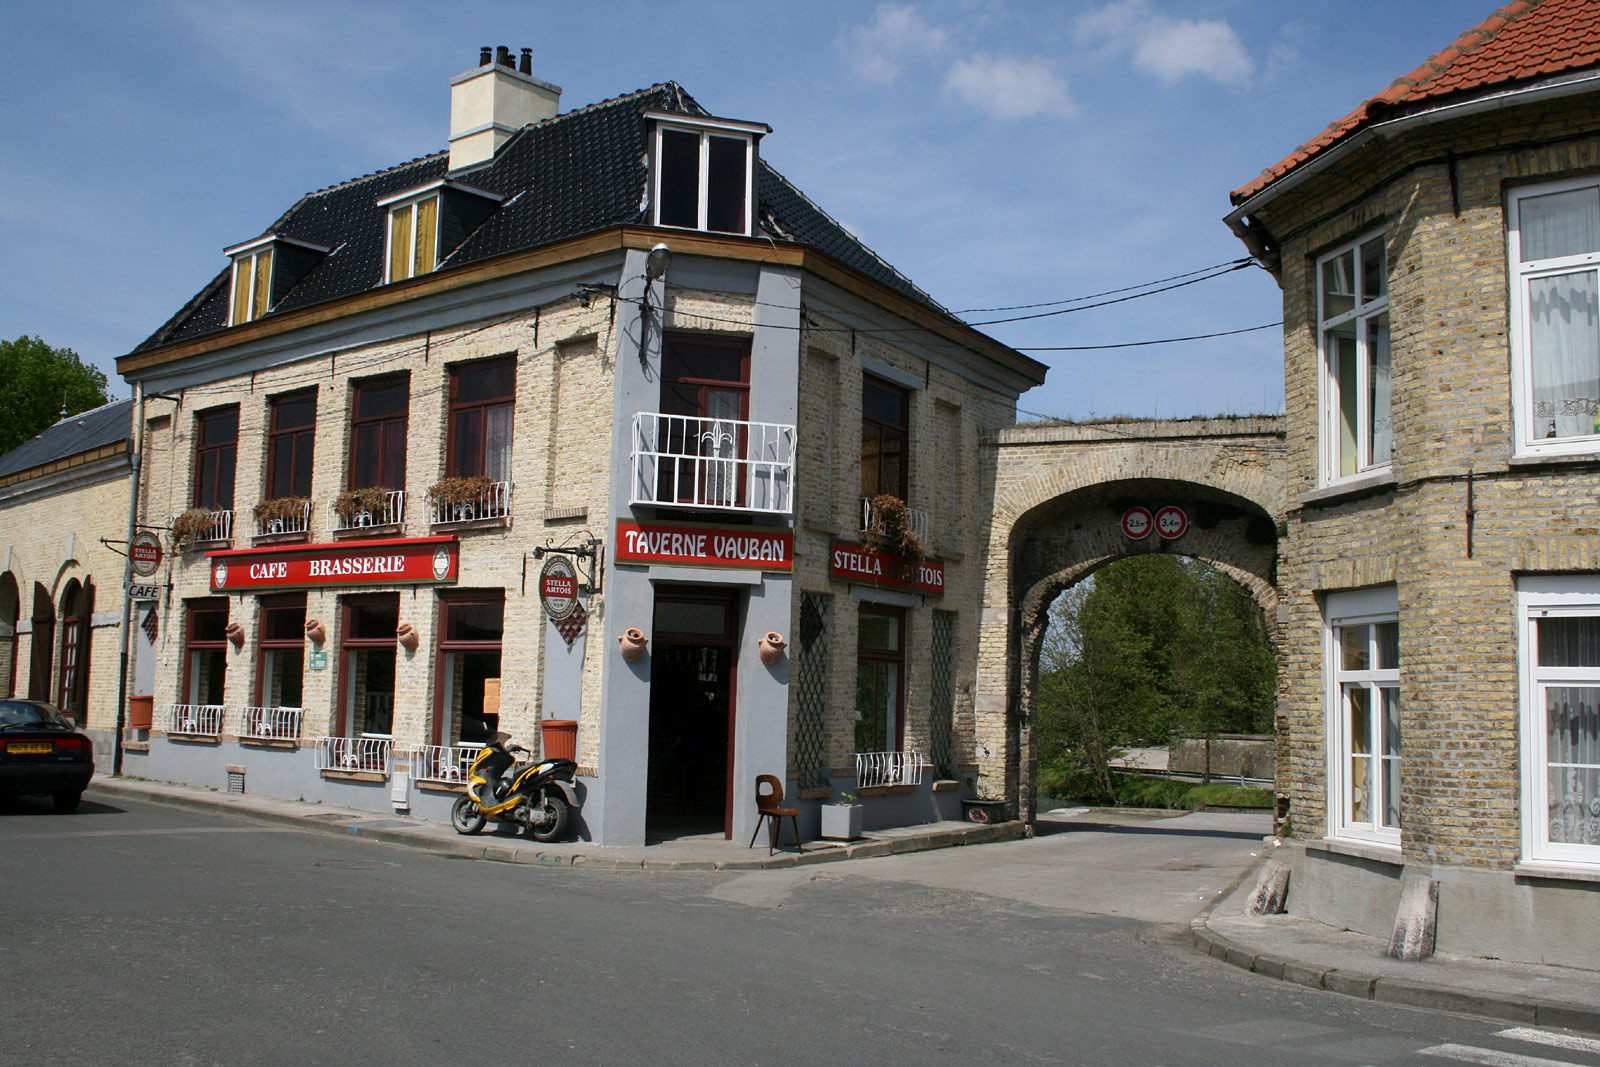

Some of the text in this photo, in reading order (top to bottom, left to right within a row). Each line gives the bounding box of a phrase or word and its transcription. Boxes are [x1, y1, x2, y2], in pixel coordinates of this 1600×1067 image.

[625, 530, 785, 562] TAVERNE VAUBAN
[249, 555, 405, 580] CAFE BRASSERIE
[834, 550, 882, 576] STELLA
[128, 585, 160, 598] CAFE
[545, 586, 572, 595] ARTOIS
[546, 579, 572, 588] STELLA
